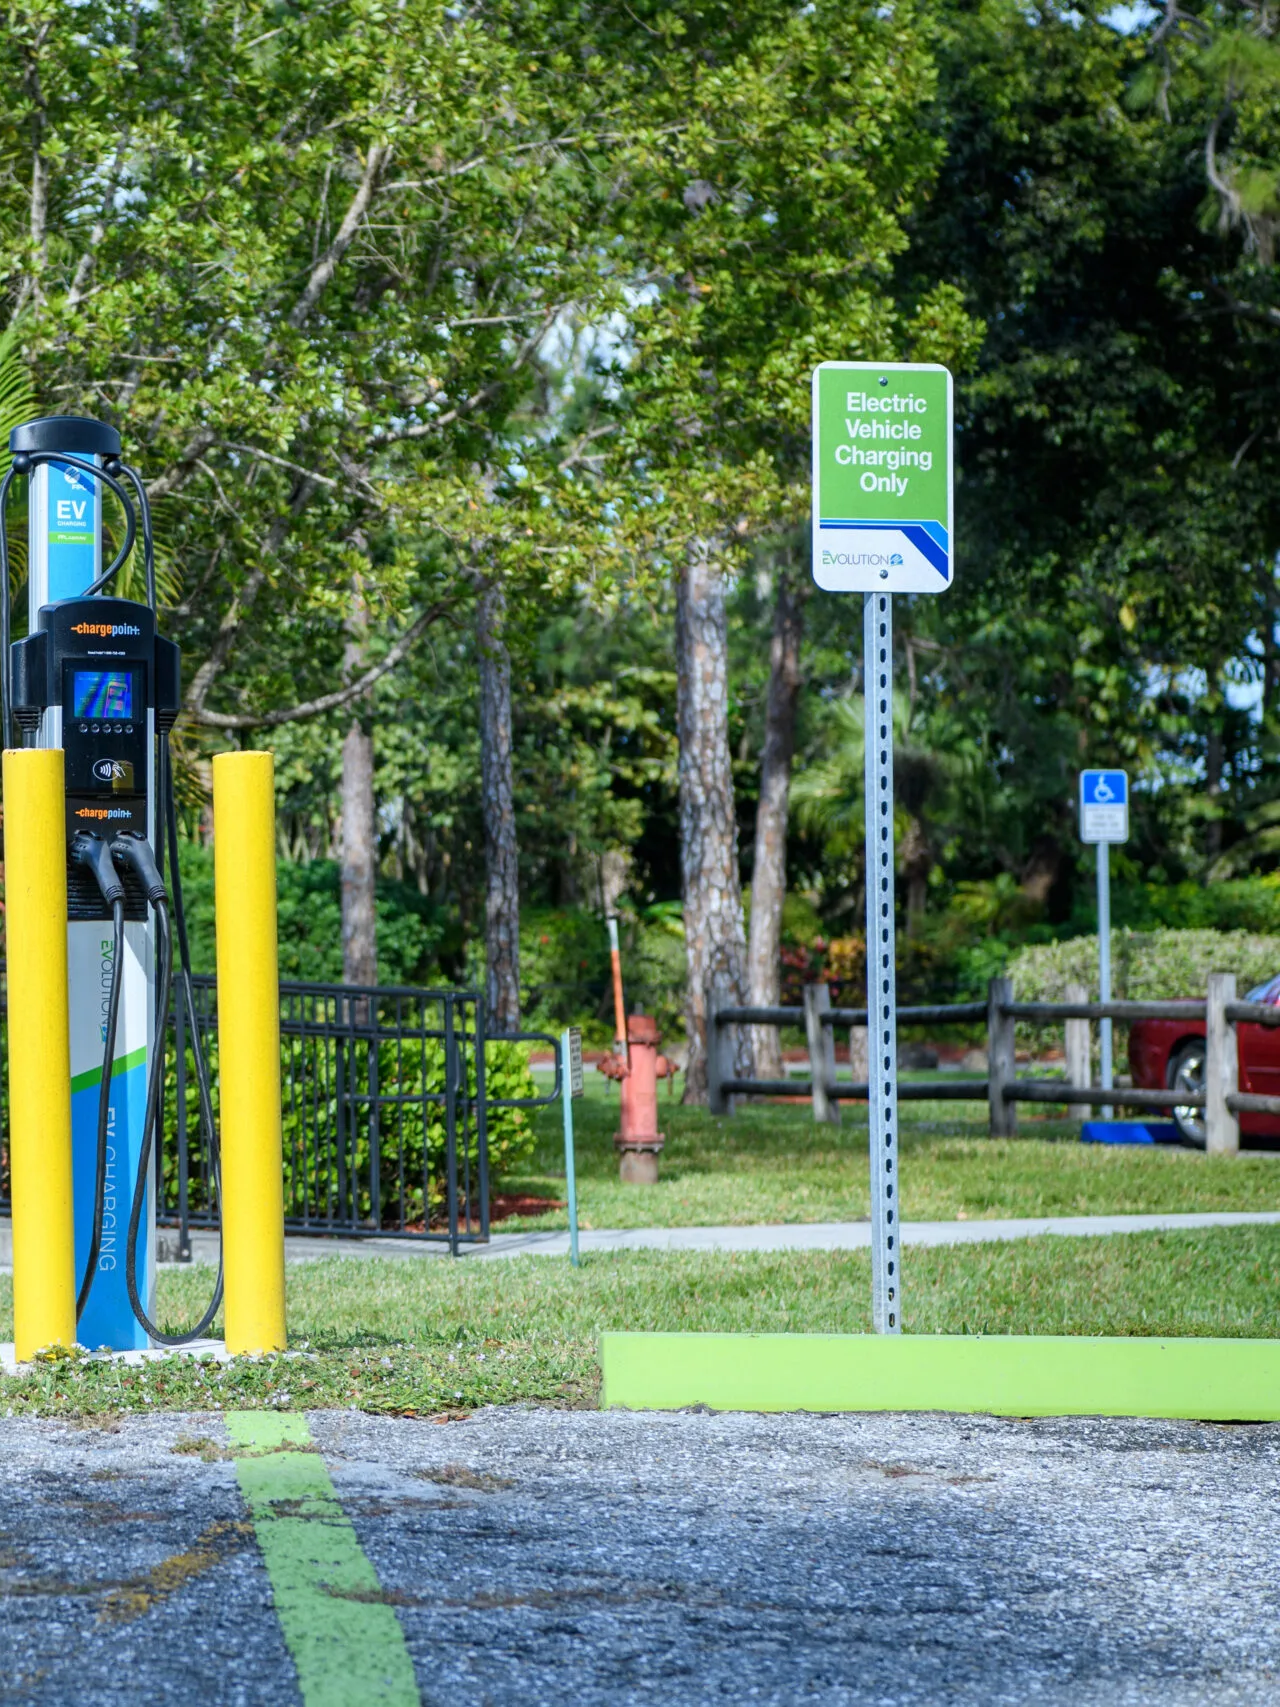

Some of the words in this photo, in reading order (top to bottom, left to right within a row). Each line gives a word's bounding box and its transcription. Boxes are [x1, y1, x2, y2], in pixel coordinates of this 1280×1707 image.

[846, 391, 927, 414] Electric
[845, 418, 922, 440] Vehicle
[834, 444, 933, 471] Charging
[859, 472, 909, 497] Only
[56, 499, 87, 520] EV
[822, 552, 889, 566] EVOLUTION
[101, 940, 114, 1025] EVOLUTION
